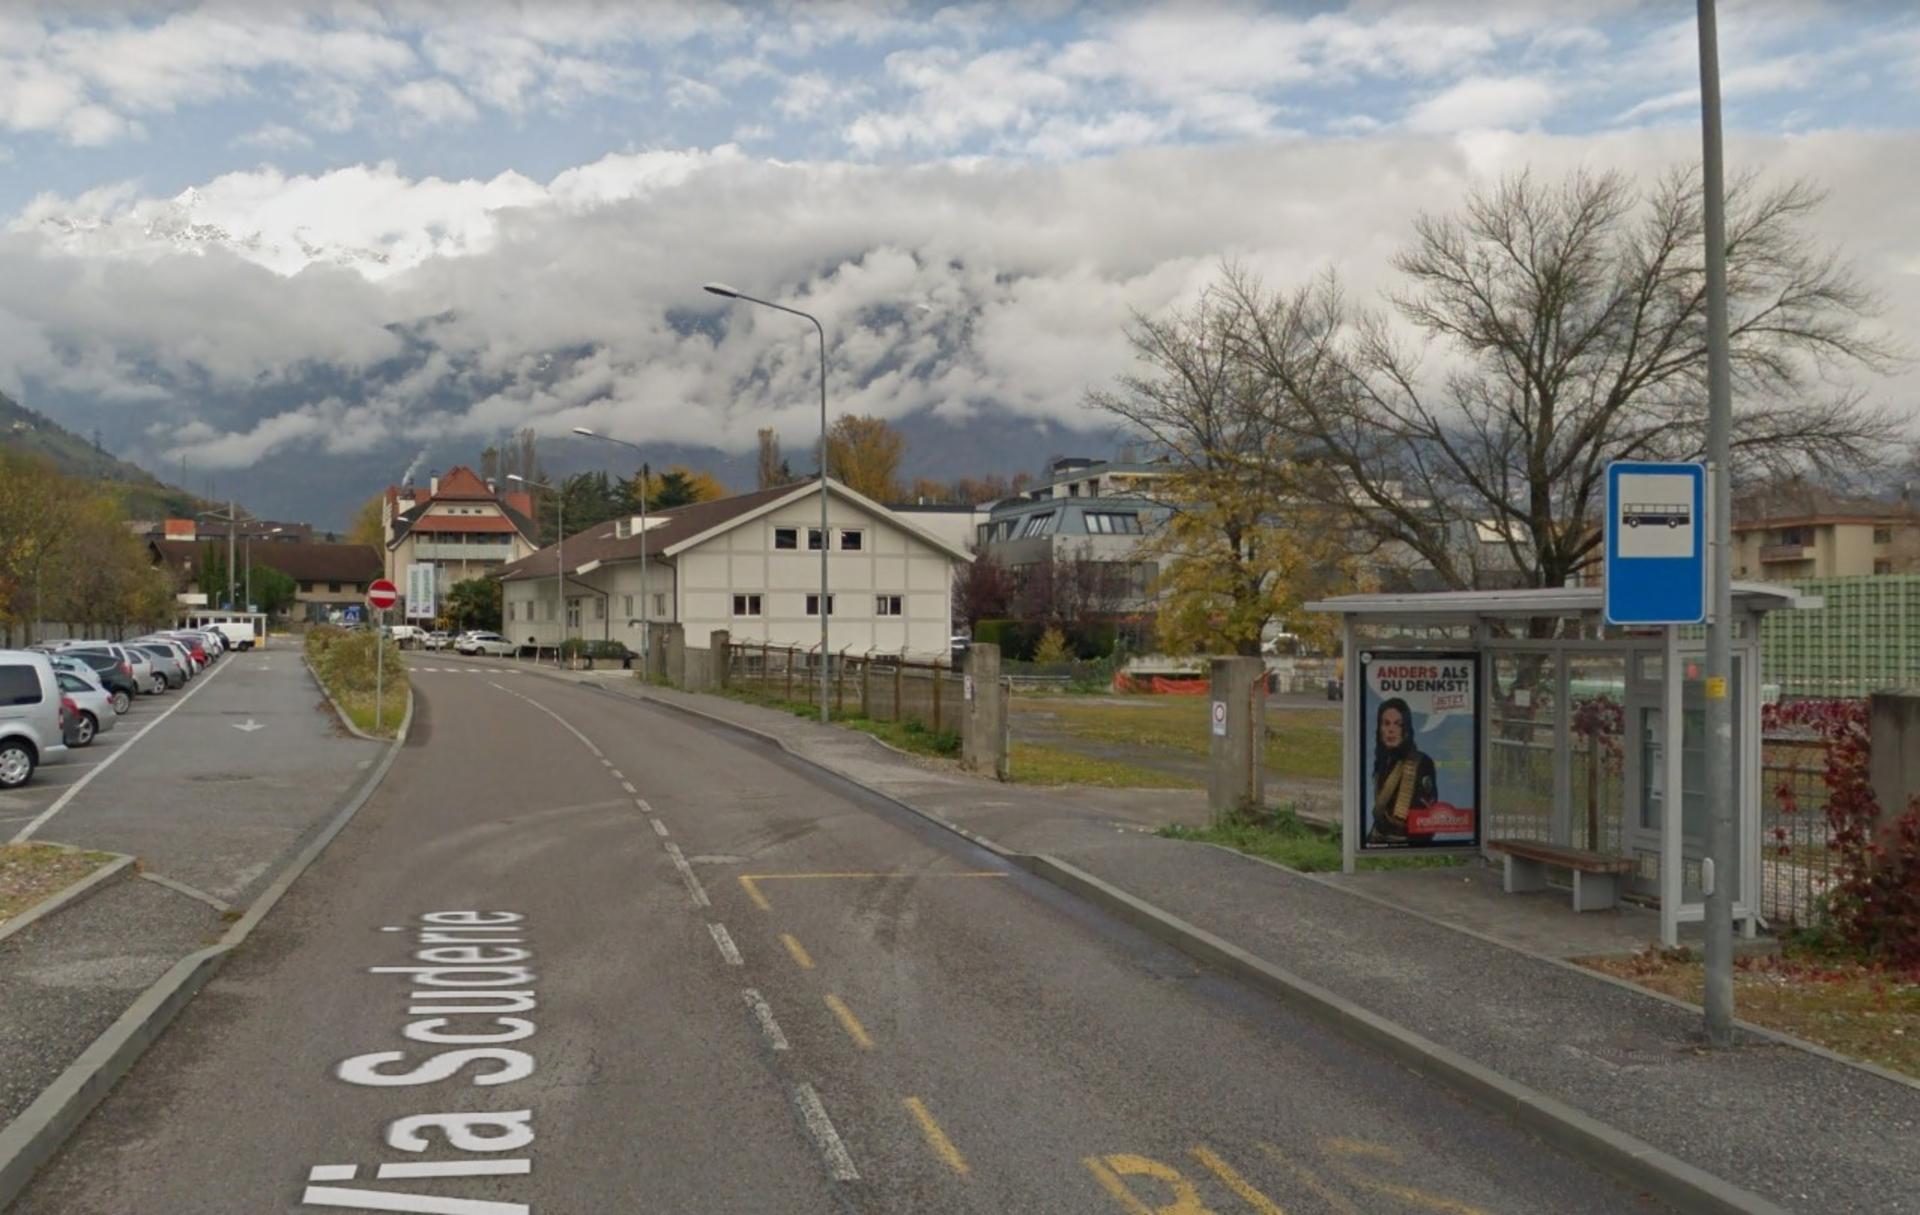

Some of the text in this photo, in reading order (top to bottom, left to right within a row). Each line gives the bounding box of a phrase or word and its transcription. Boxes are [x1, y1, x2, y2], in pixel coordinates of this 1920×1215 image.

[1377, 666, 1468, 678] ANDERS ALS
[1380, 680, 1469, 693] DU DENKST!
